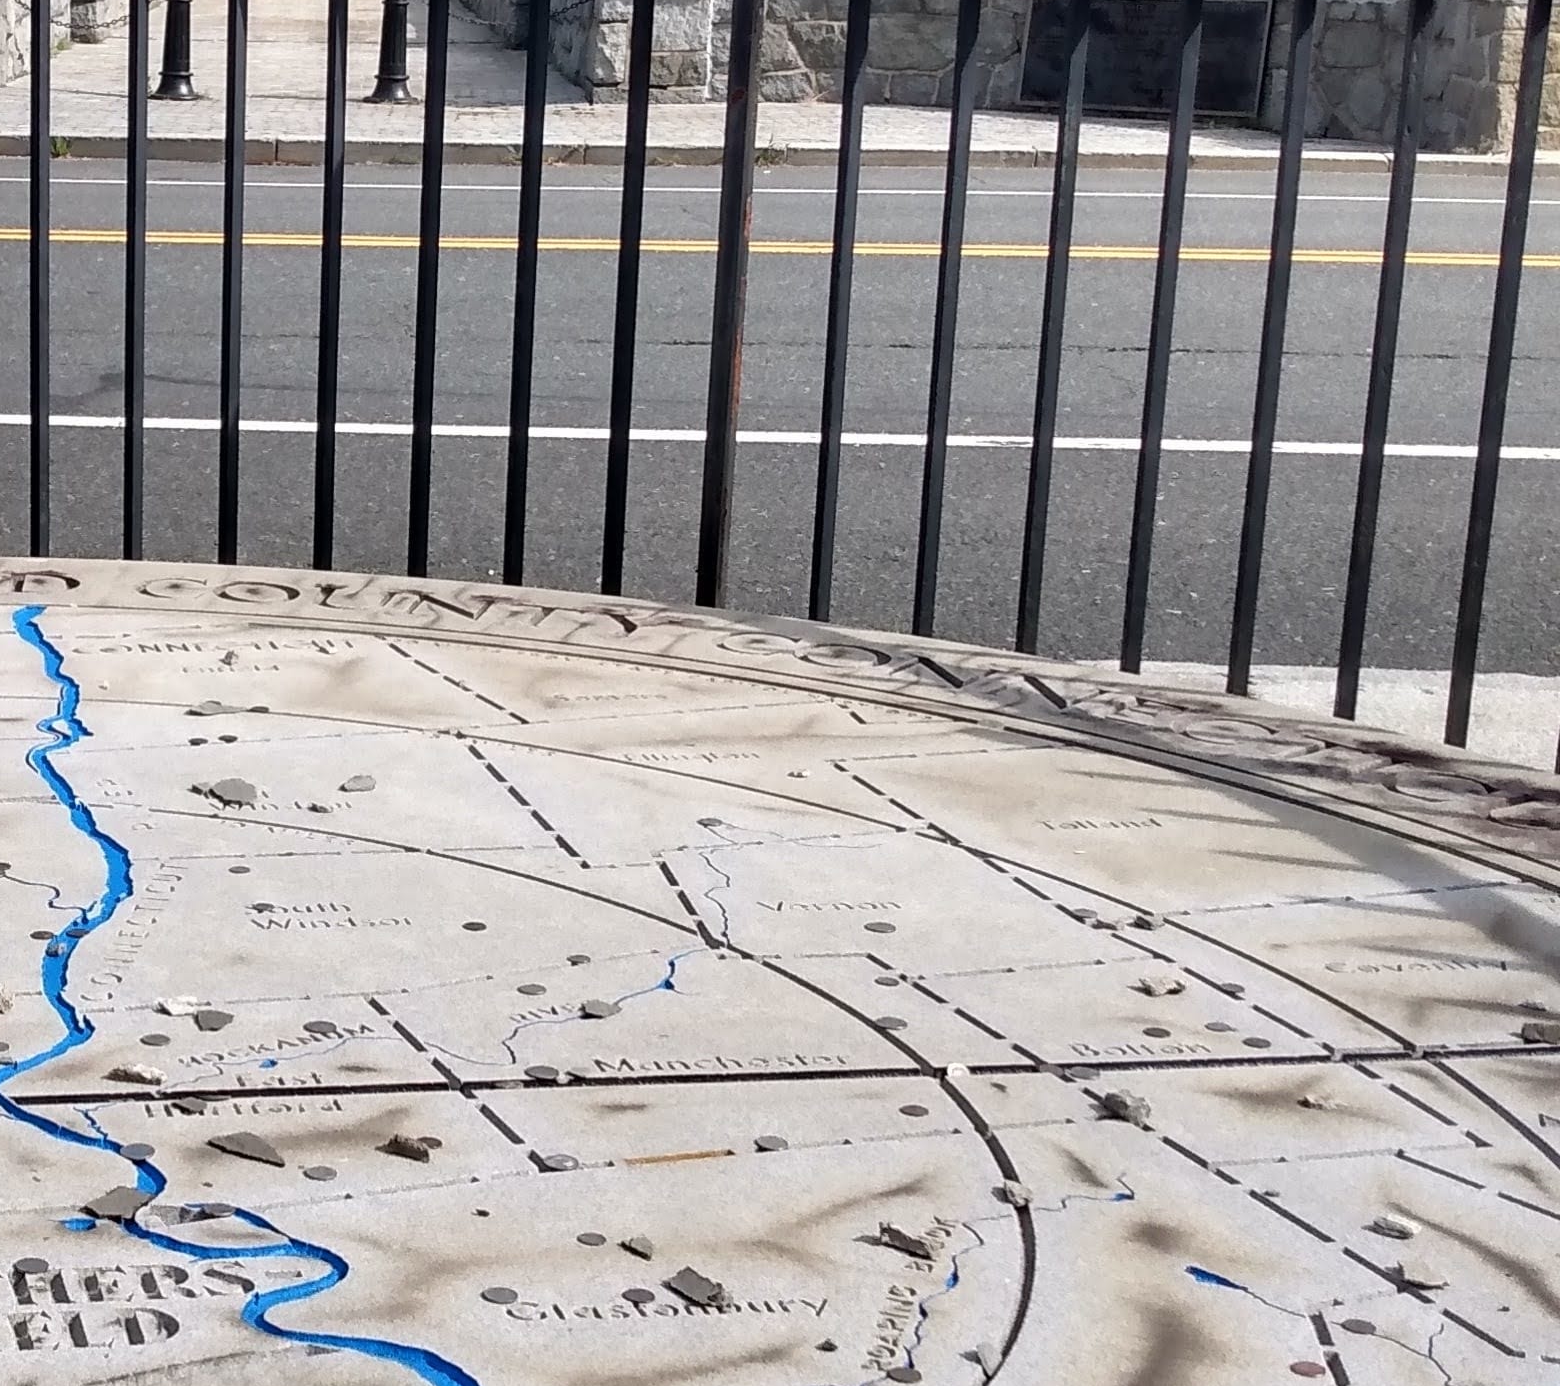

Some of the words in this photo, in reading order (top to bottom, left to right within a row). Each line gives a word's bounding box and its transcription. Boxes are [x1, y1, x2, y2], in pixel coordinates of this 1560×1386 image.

[137, 577, 640, 634] COUNTY
[756, 898, 903, 914] Vernon
[1323, 957, 1510, 977] Coventry
[1070, 1038, 1213, 1059] Bolton
[590, 1053, 850, 1073] Manchester
